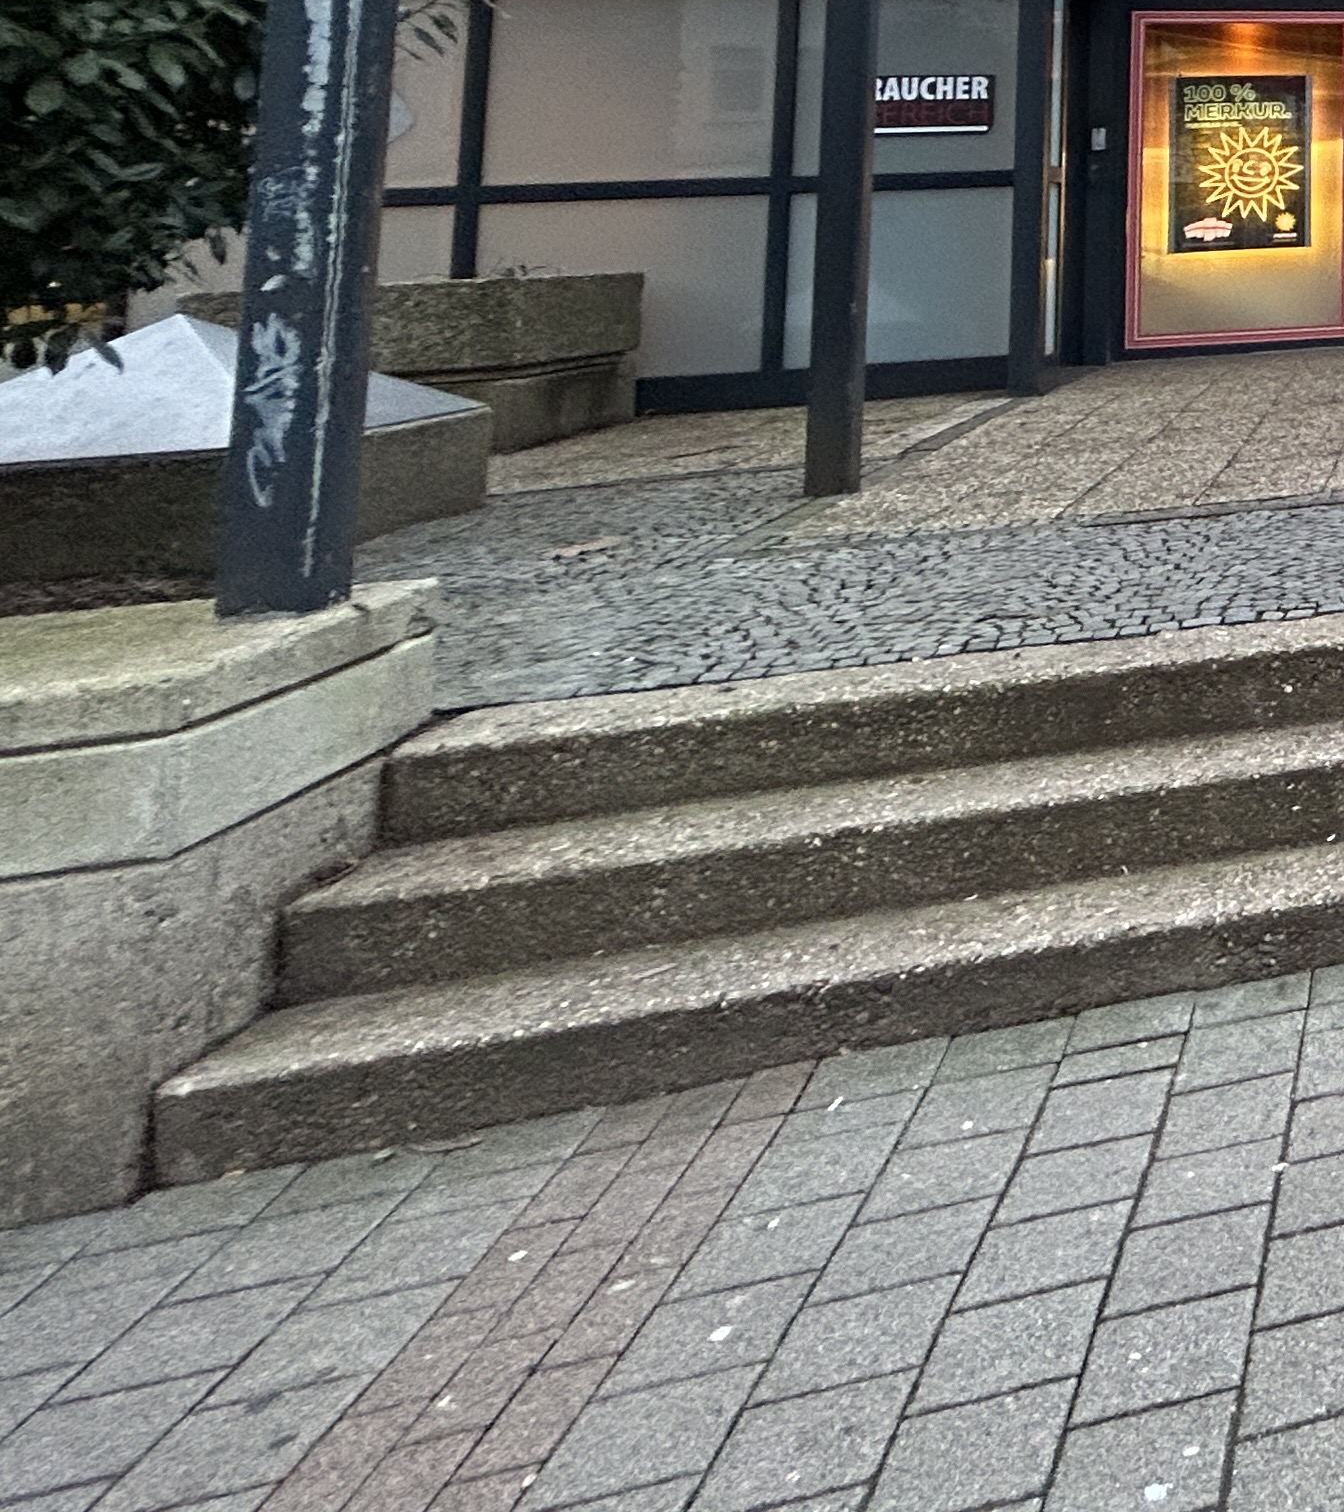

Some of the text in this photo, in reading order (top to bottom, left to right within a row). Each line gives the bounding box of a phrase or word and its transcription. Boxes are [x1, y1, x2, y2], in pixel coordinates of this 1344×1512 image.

[1183, 83, 1257, 103] 100 %
[1184, 101, 1292, 121] MERKUR.
